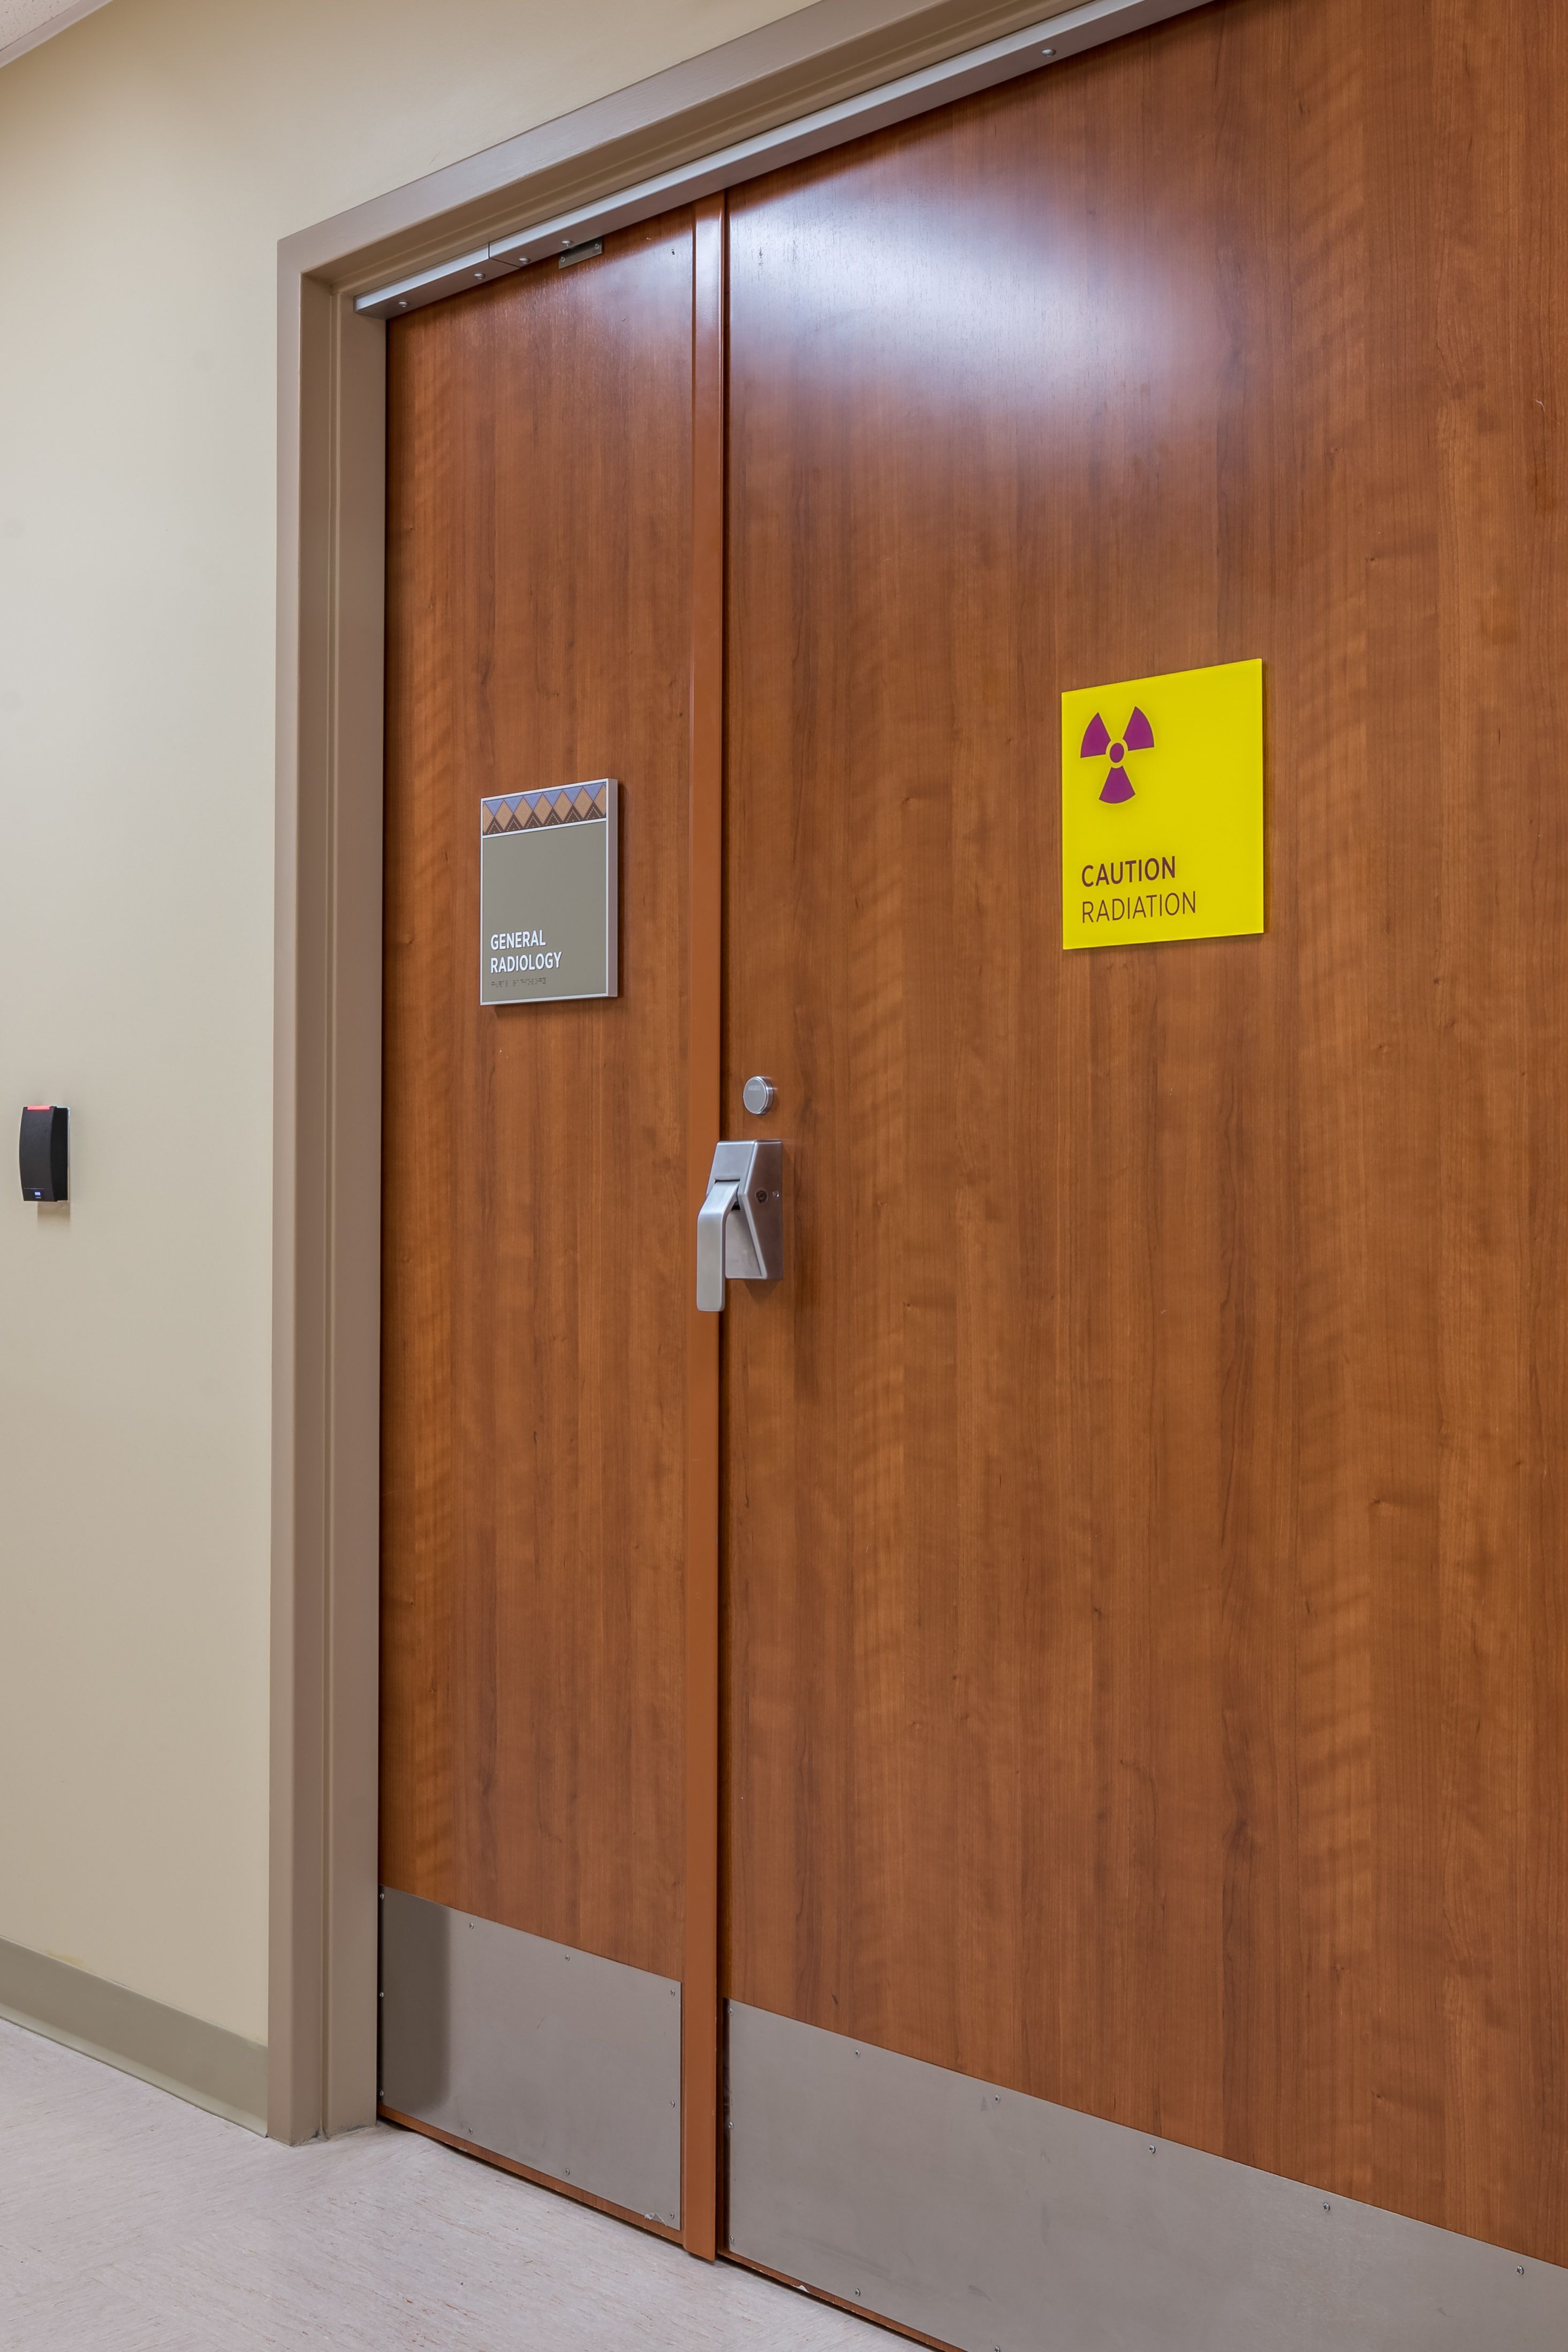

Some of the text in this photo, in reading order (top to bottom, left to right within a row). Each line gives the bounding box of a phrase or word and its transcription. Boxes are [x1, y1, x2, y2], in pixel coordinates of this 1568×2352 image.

[1081, 856, 1176, 887] CAUTION
[1082, 890, 1196, 924] RADIATION
[490, 929, 546, 950] GENERAL
[490, 951, 562, 973] RADIOLOGY
